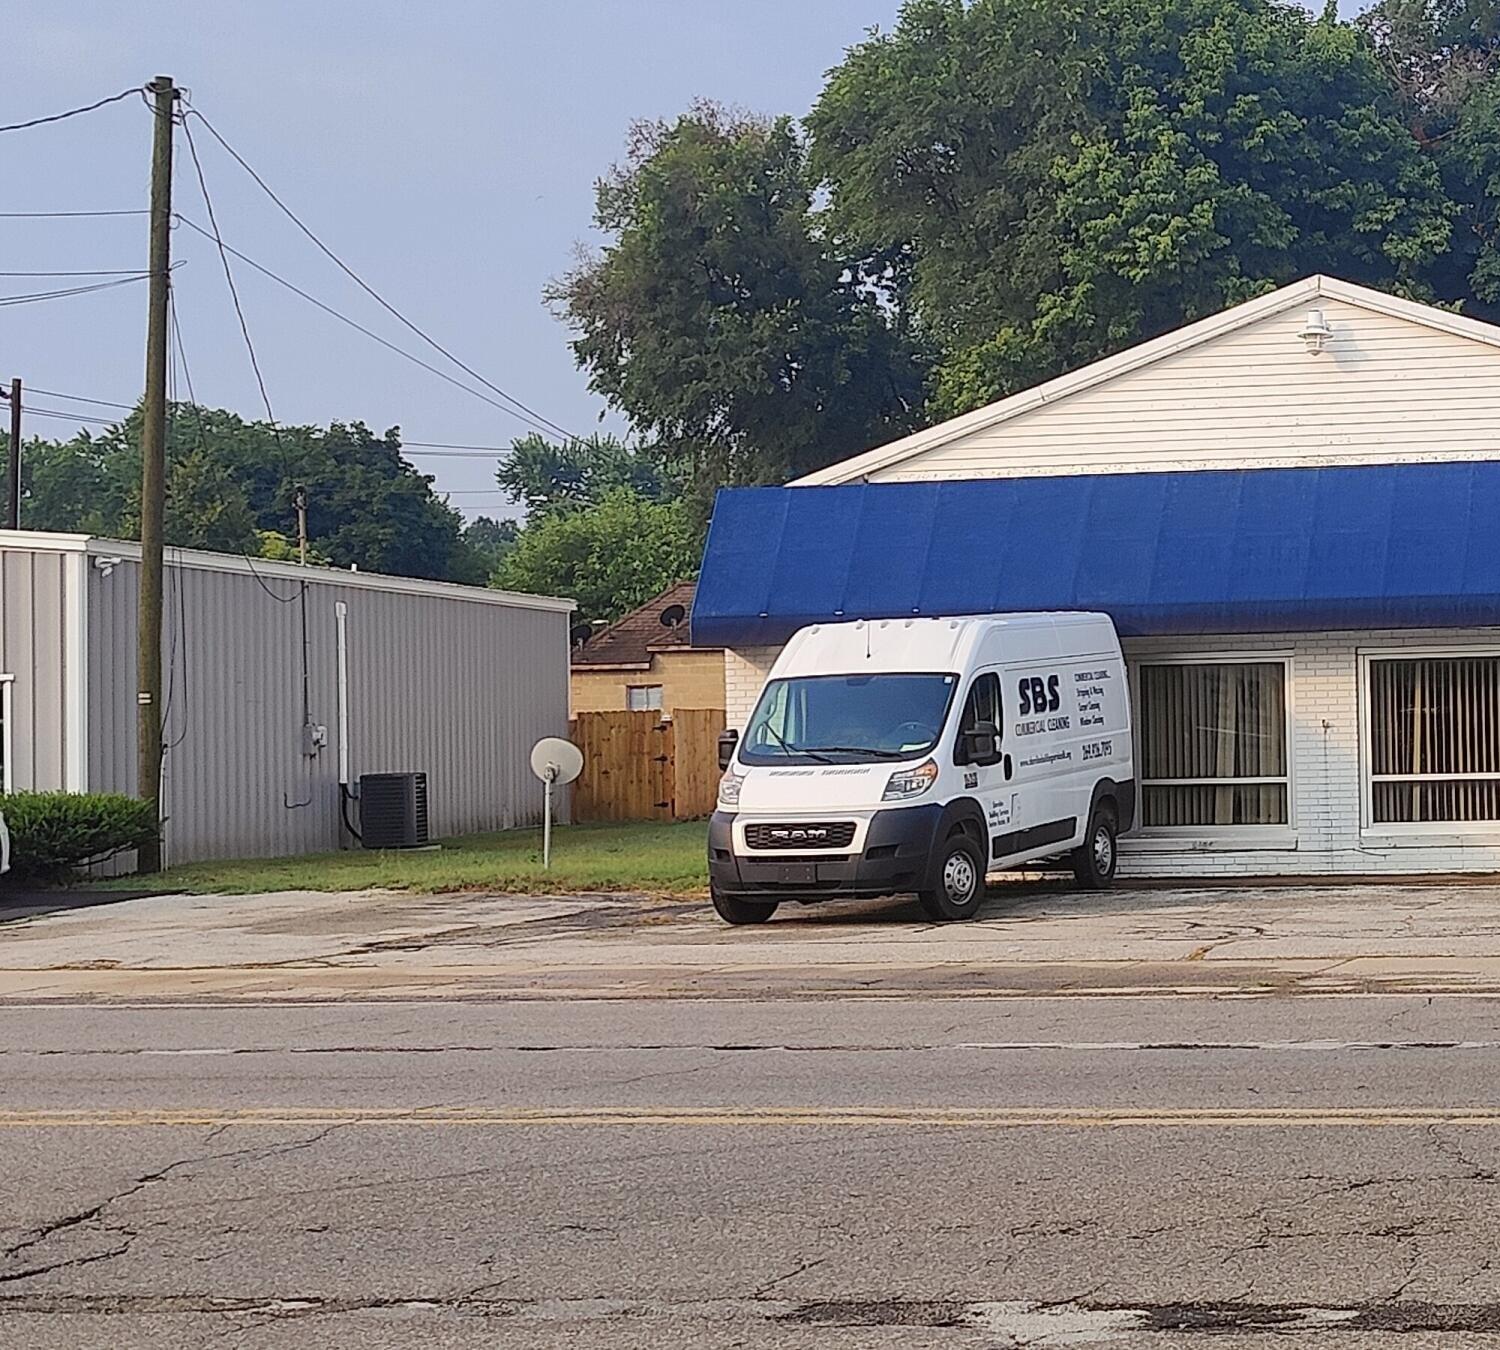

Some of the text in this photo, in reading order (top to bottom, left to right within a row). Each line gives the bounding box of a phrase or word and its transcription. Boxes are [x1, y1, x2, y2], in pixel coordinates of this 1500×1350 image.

[1018, 674, 1060, 717] SBS
[1015, 716, 1070, 737] COMMERCIAL CLEANING
[771, 829, 827, 839] RAM
